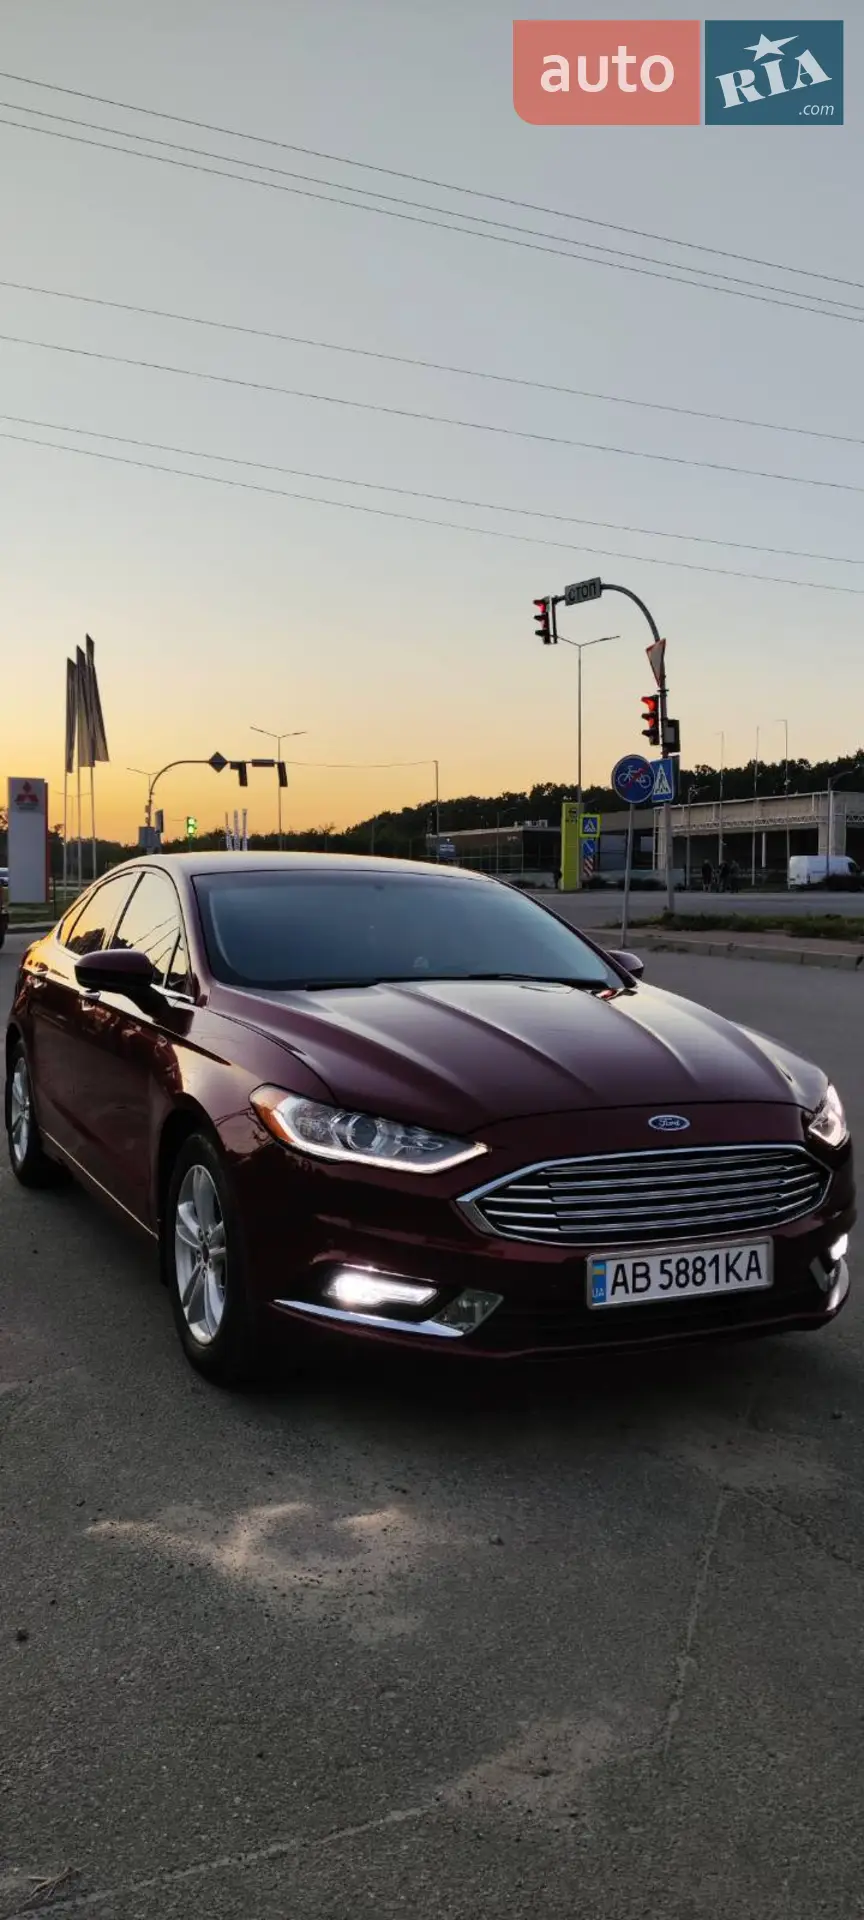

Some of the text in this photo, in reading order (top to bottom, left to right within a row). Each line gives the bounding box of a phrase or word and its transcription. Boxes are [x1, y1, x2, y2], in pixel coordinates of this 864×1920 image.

[568, 582, 596, 601] СТОП
[658, 1117, 681, 1128] Ford
[610, 1261, 651, 1296] AB
[592, 1287, 605, 1298] UA
